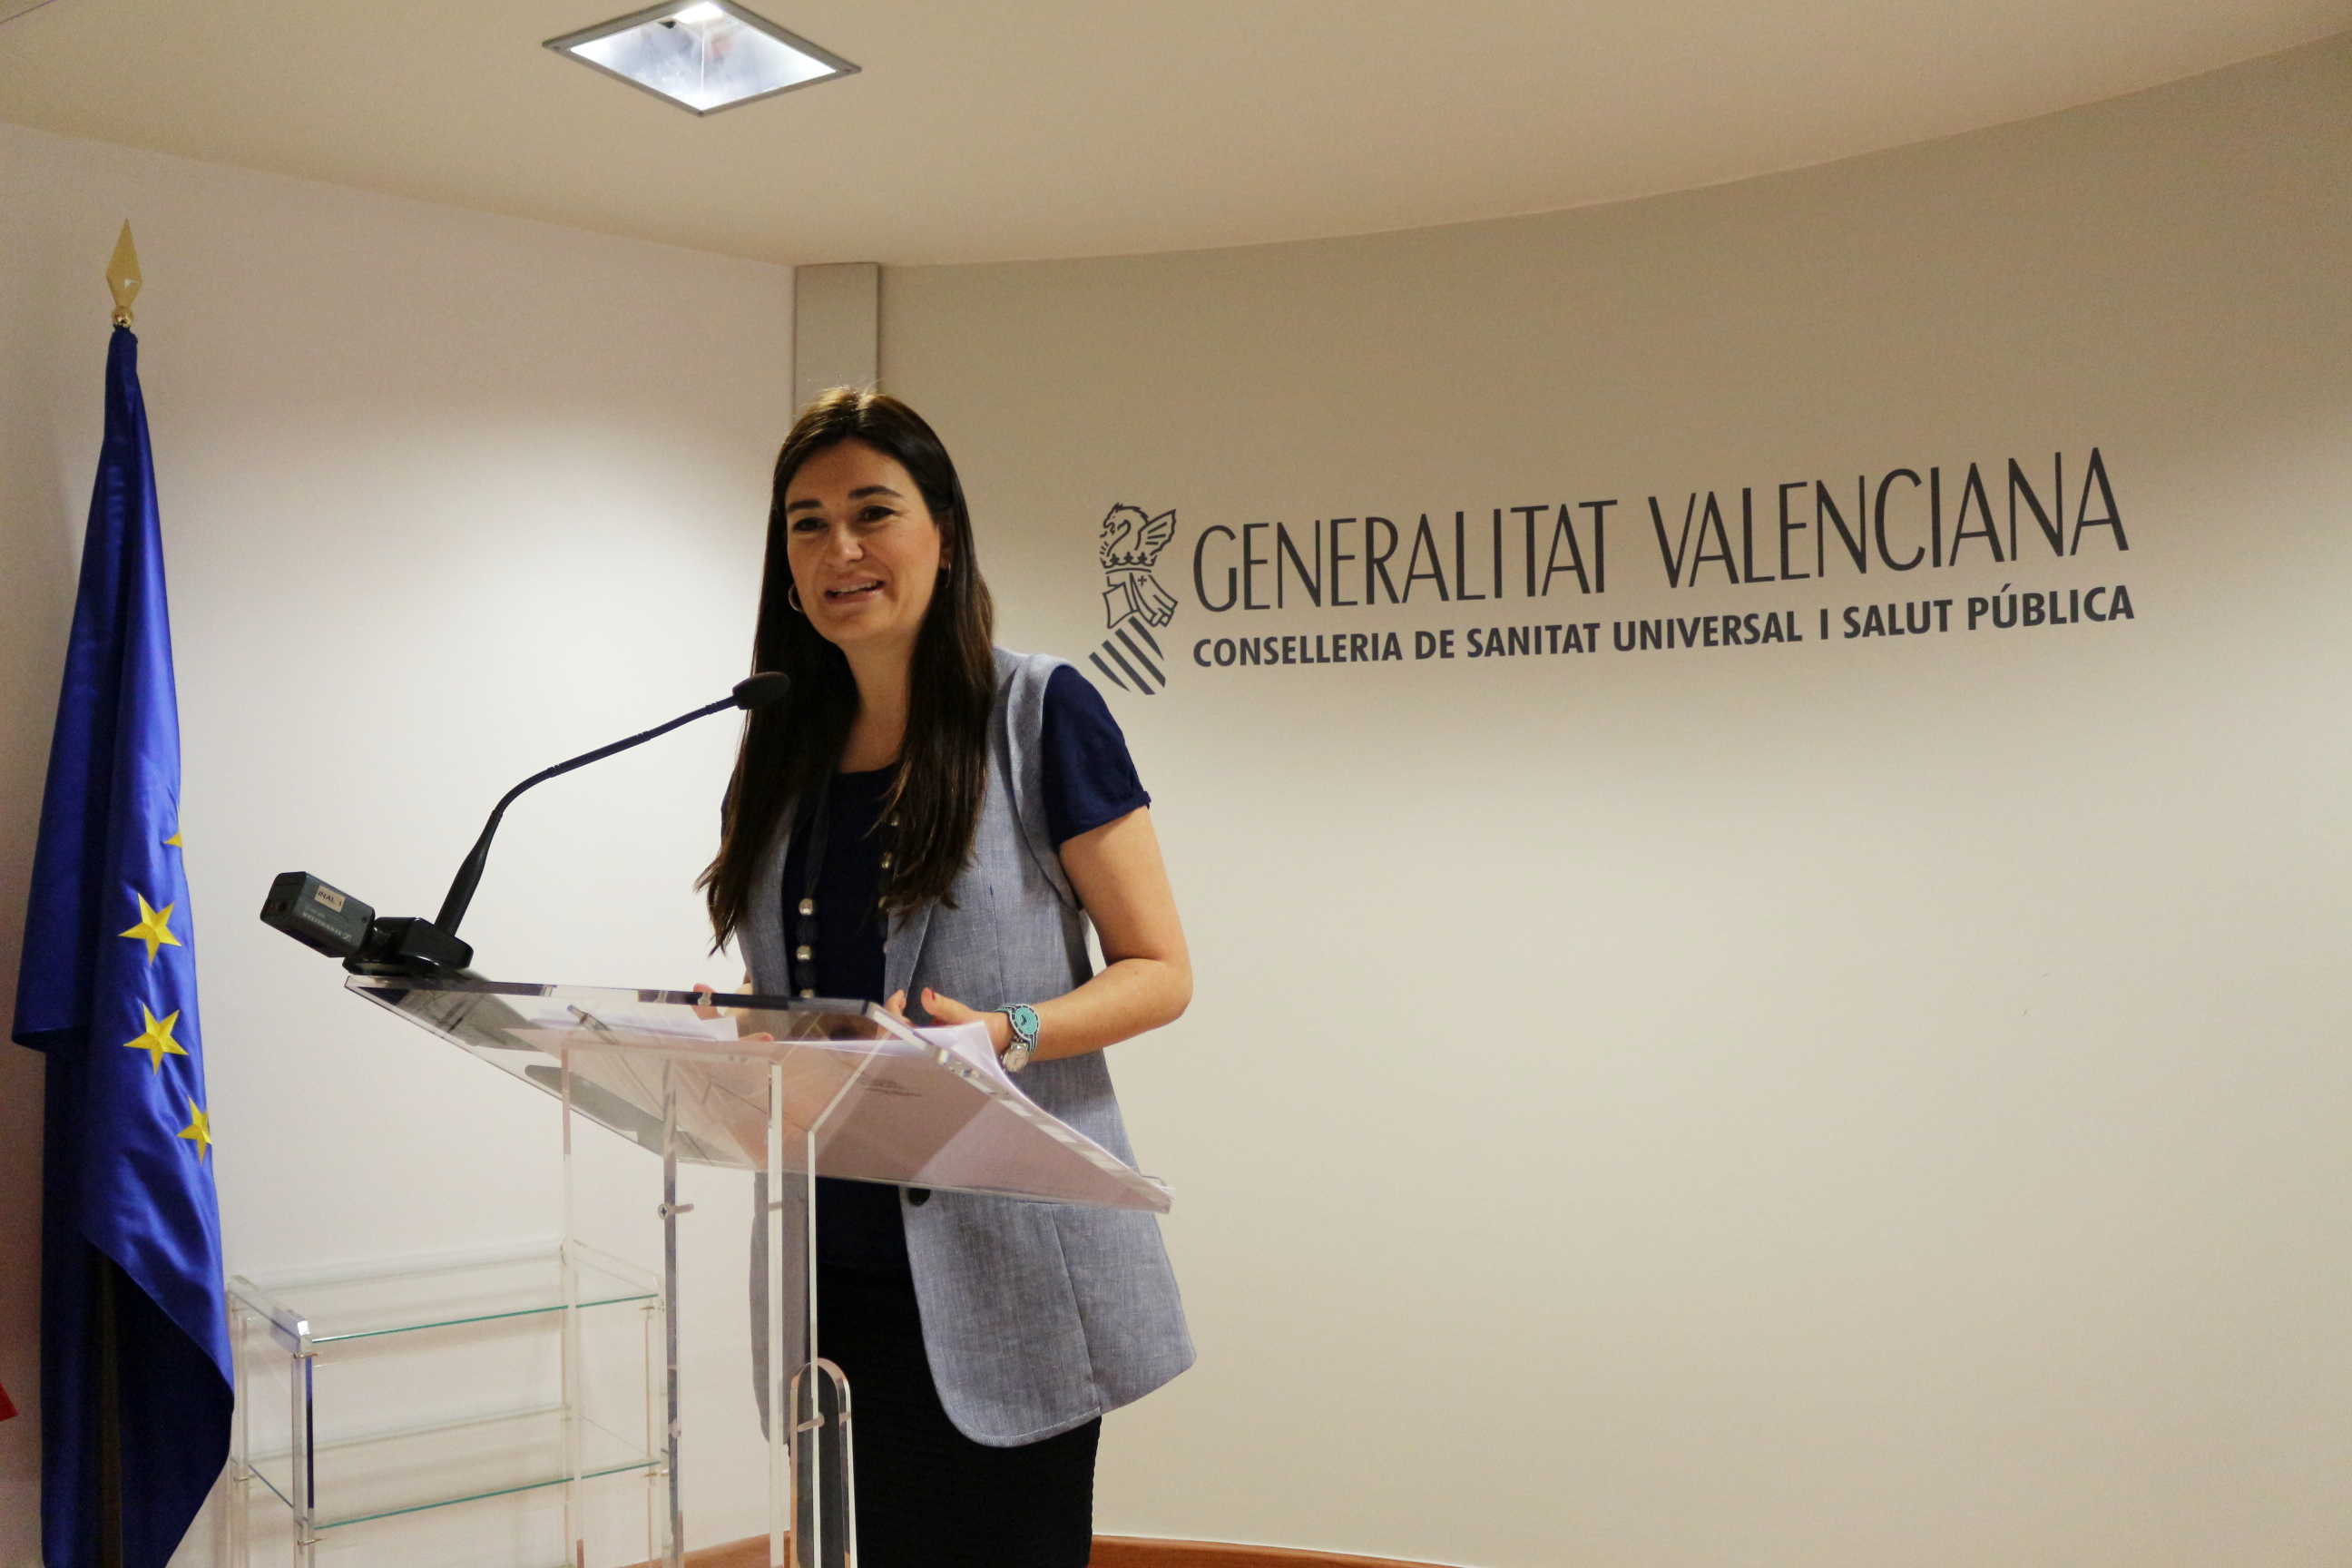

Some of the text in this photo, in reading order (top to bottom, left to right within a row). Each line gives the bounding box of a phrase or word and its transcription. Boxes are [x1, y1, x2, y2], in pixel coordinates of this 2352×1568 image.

[1192, 446, 2130, 612] GENERALITAT VALENCIANA
[1192, 583, 2136, 668] CONSELLERIA DE SANITAT UNIVERSAL I SALUT PÚBLICA
